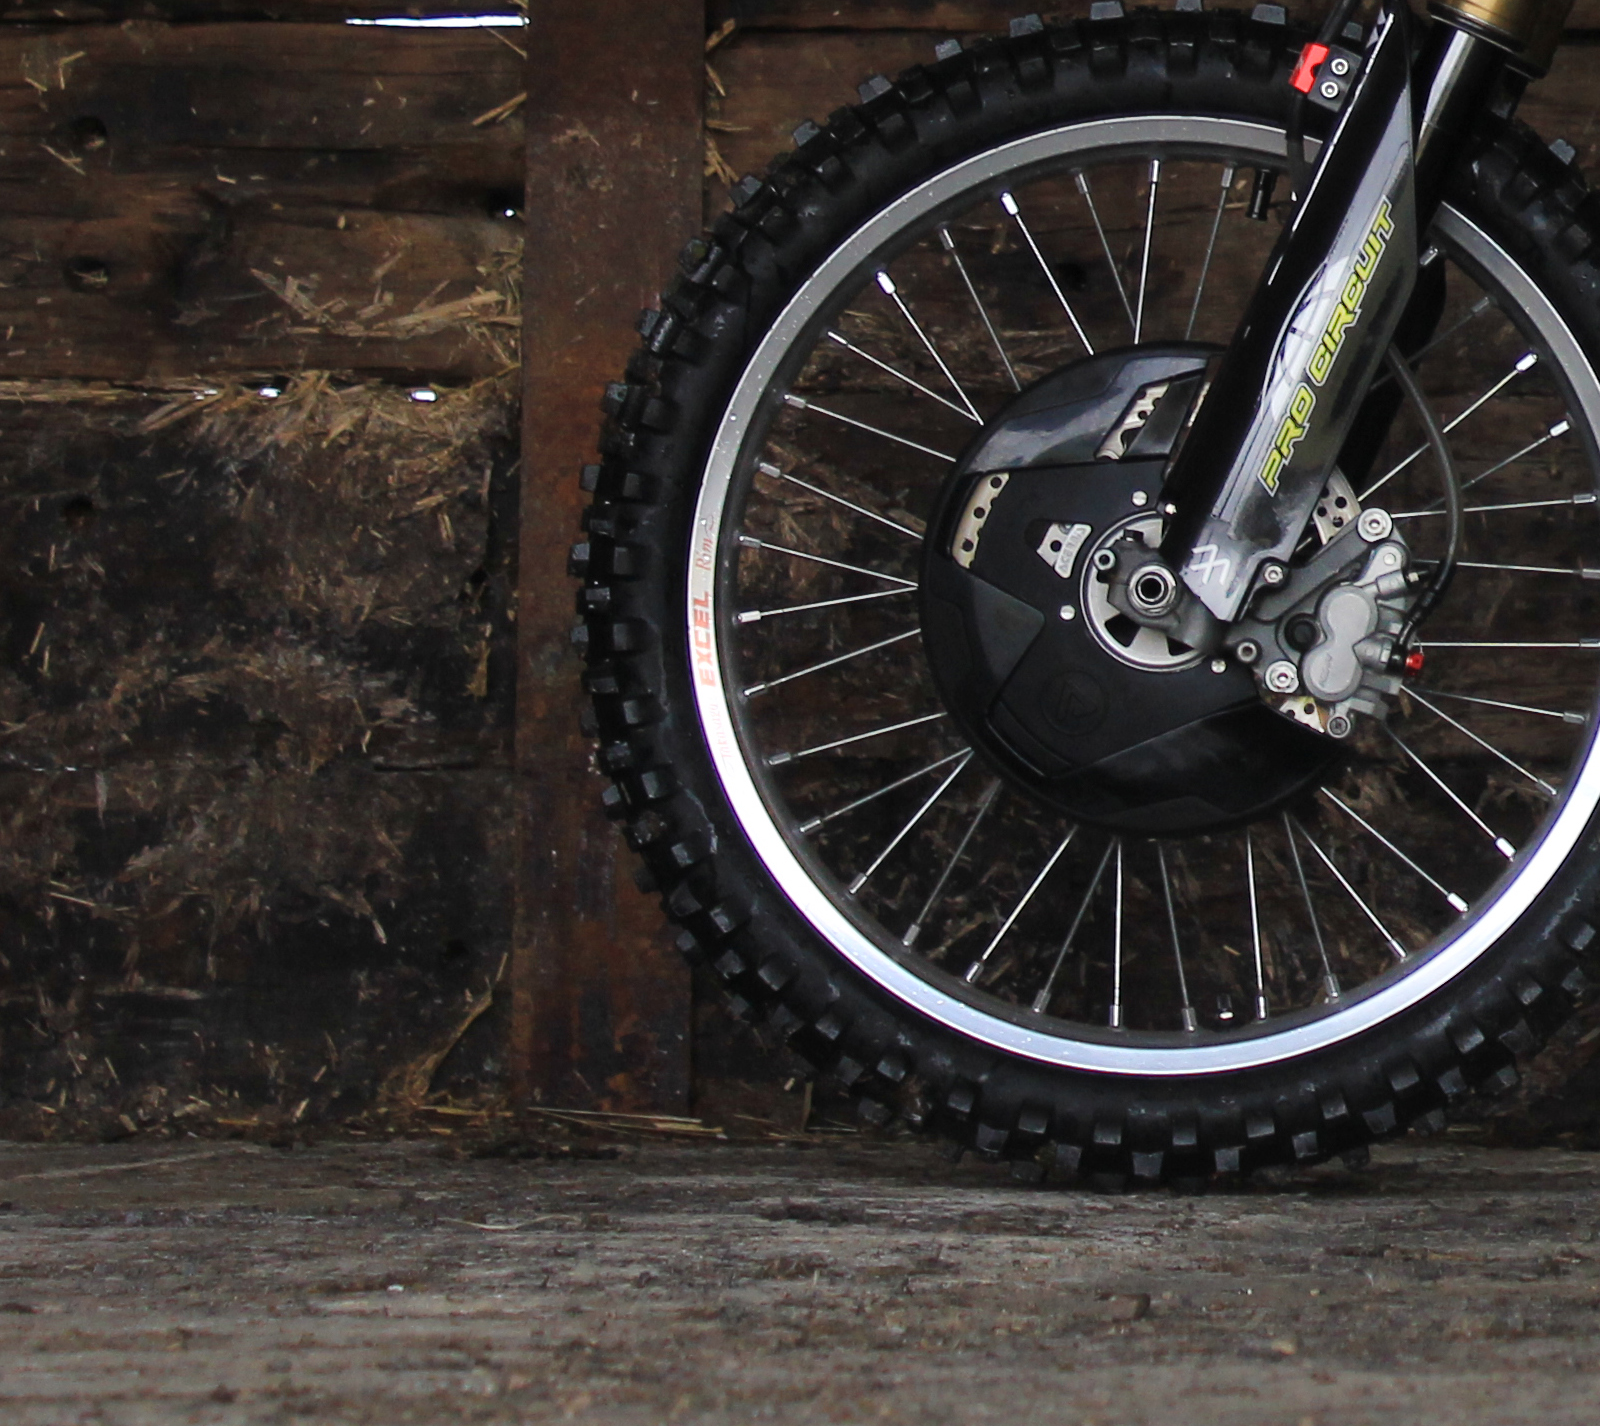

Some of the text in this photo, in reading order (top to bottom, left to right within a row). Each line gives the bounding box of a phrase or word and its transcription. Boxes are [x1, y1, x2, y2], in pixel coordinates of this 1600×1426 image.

[1257, 194, 1396, 497] PRO CIRCUIT
[693, 590, 718, 688] EXCEL
